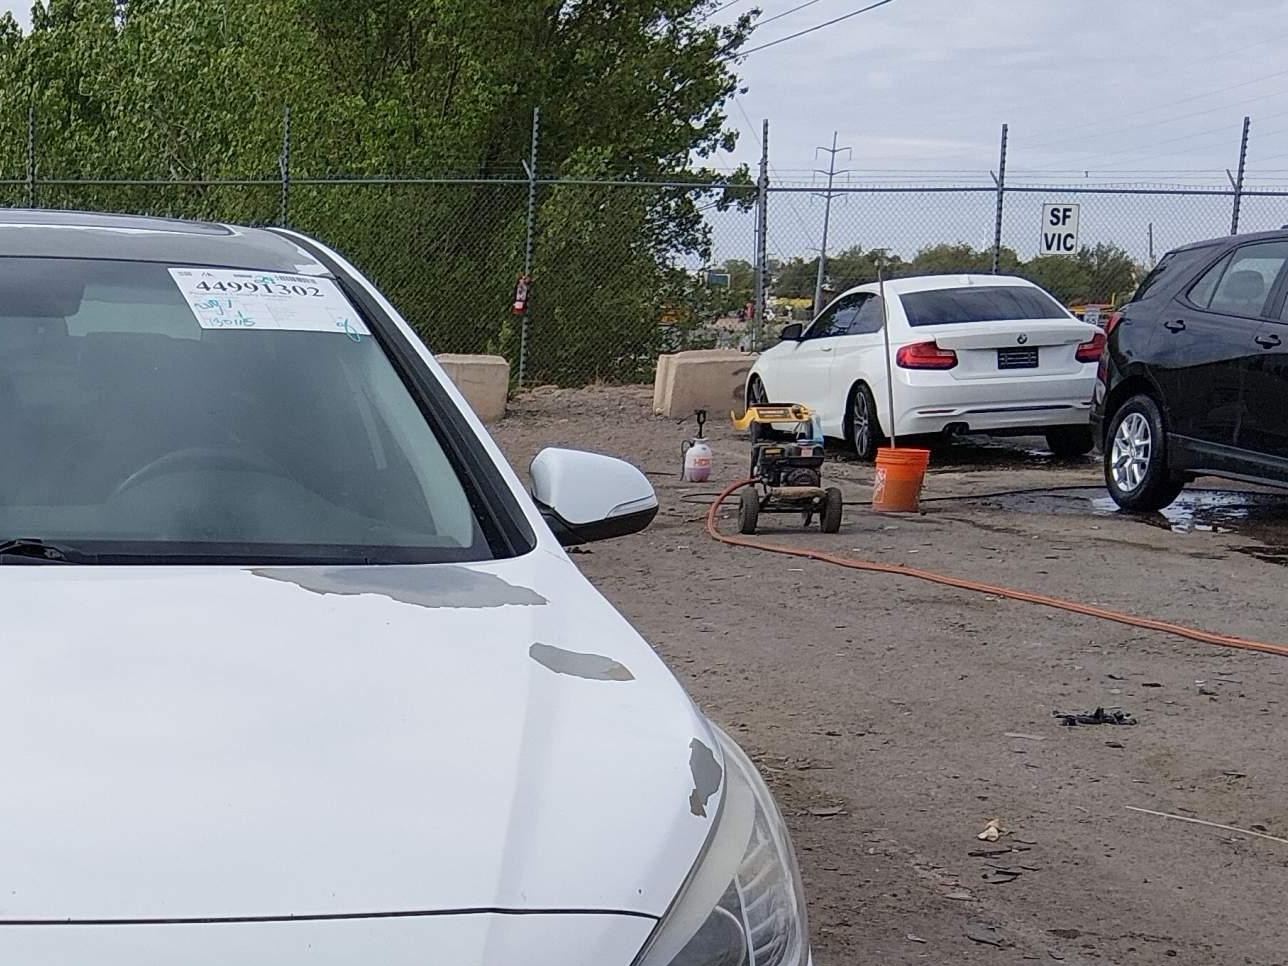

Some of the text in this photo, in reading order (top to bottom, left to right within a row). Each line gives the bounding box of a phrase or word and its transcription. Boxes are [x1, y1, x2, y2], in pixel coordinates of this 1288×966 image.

[1049, 207, 1072, 226] SF
[1044, 232, 1075, 252] VIC
[196, 280, 324, 298] 44991302
